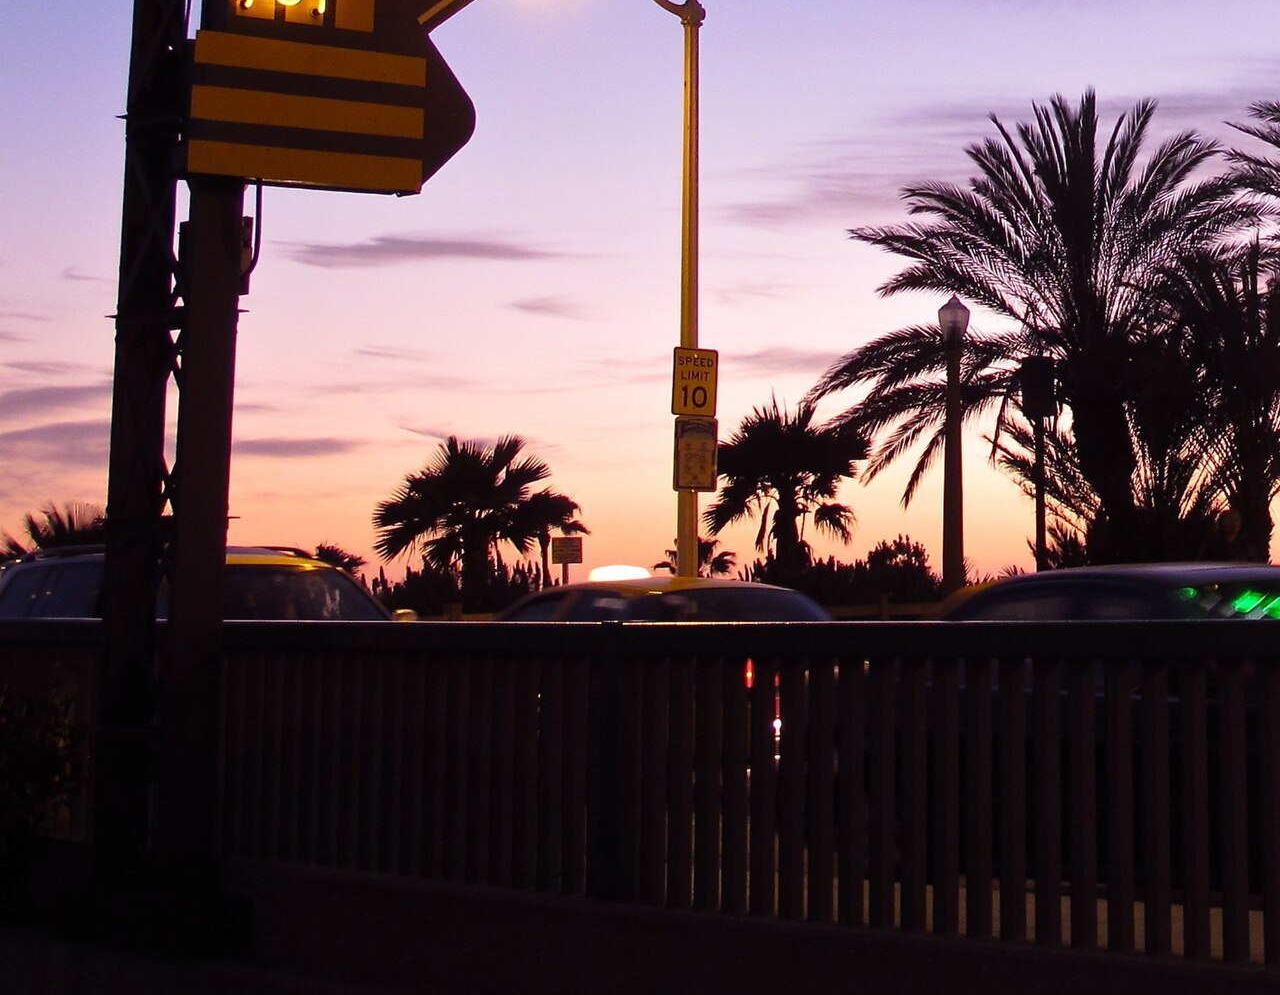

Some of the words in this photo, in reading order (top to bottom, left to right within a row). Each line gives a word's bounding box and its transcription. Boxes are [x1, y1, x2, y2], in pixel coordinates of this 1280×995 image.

[678, 355, 714, 368] SPEED
[680, 370, 711, 382] LIMIT
[681, 384, 708, 409] 10
